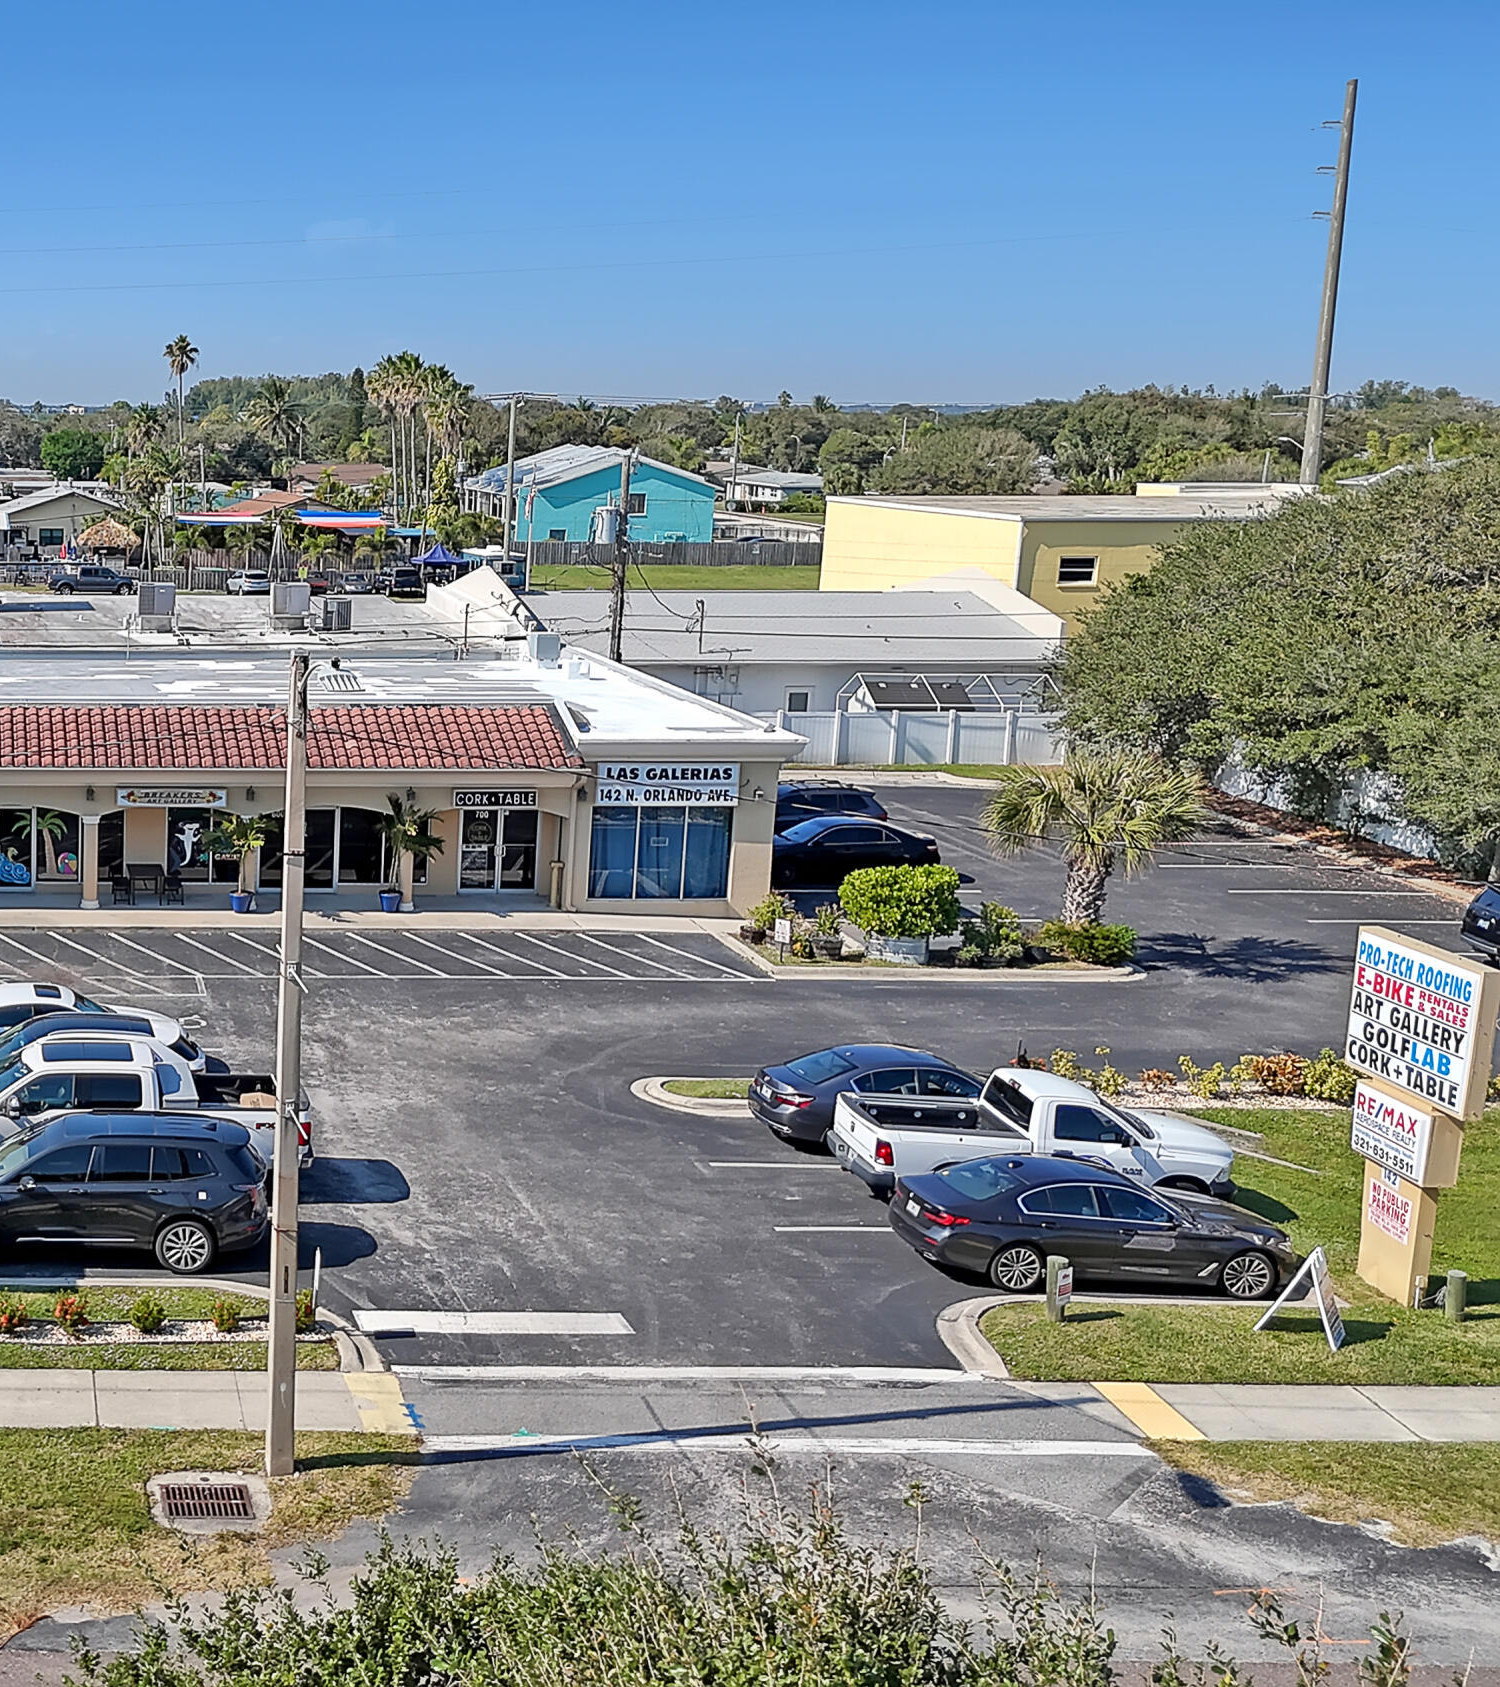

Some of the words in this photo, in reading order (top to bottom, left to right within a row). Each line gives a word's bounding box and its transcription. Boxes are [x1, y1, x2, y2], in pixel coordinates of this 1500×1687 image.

[606, 767, 639, 780] LAS
[645, 767, 733, 781] GALERIAS
[143, 791, 201, 799] BREAKERS
[456, 793, 489, 805] CORK
[498, 793, 534, 805] TABLE
[600, 789, 621, 801] 142
[626, 789, 638, 801] N.
[643, 788, 702, 801] ORLANDO
[707, 789, 733, 802] AVE.
[475, 811, 489, 819] 700
[1357, 965, 1415, 1008] E-BIKE
[1359, 940, 1414, 980] PRO-TECH
[1416, 962, 1472, 1002] ROOFING
[1417, 1001, 1426, 1013] &
[1430, 1006, 1466, 1029] SALES
[1418, 990, 1469, 1017] RENTALS
[1353, 990, 1384, 1020] ART
[1390, 1007, 1465, 1054] GALLERY
[1363, 1021, 1451, 1076] GOLFLAB
[1356, 1112, 1390, 1136] AEROSPACE
[1392, 1130, 1416, 1148] REALTY
[1357, 1091, 1418, 1138] RE/MAX
[1354, 1134, 1414, 1175] 321-631-5511
[1371, 1194, 1406, 1225] PARKING
[1372, 1182, 1382, 1196] NO
[1382, 1189, 1409, 1214] PUBLIC
